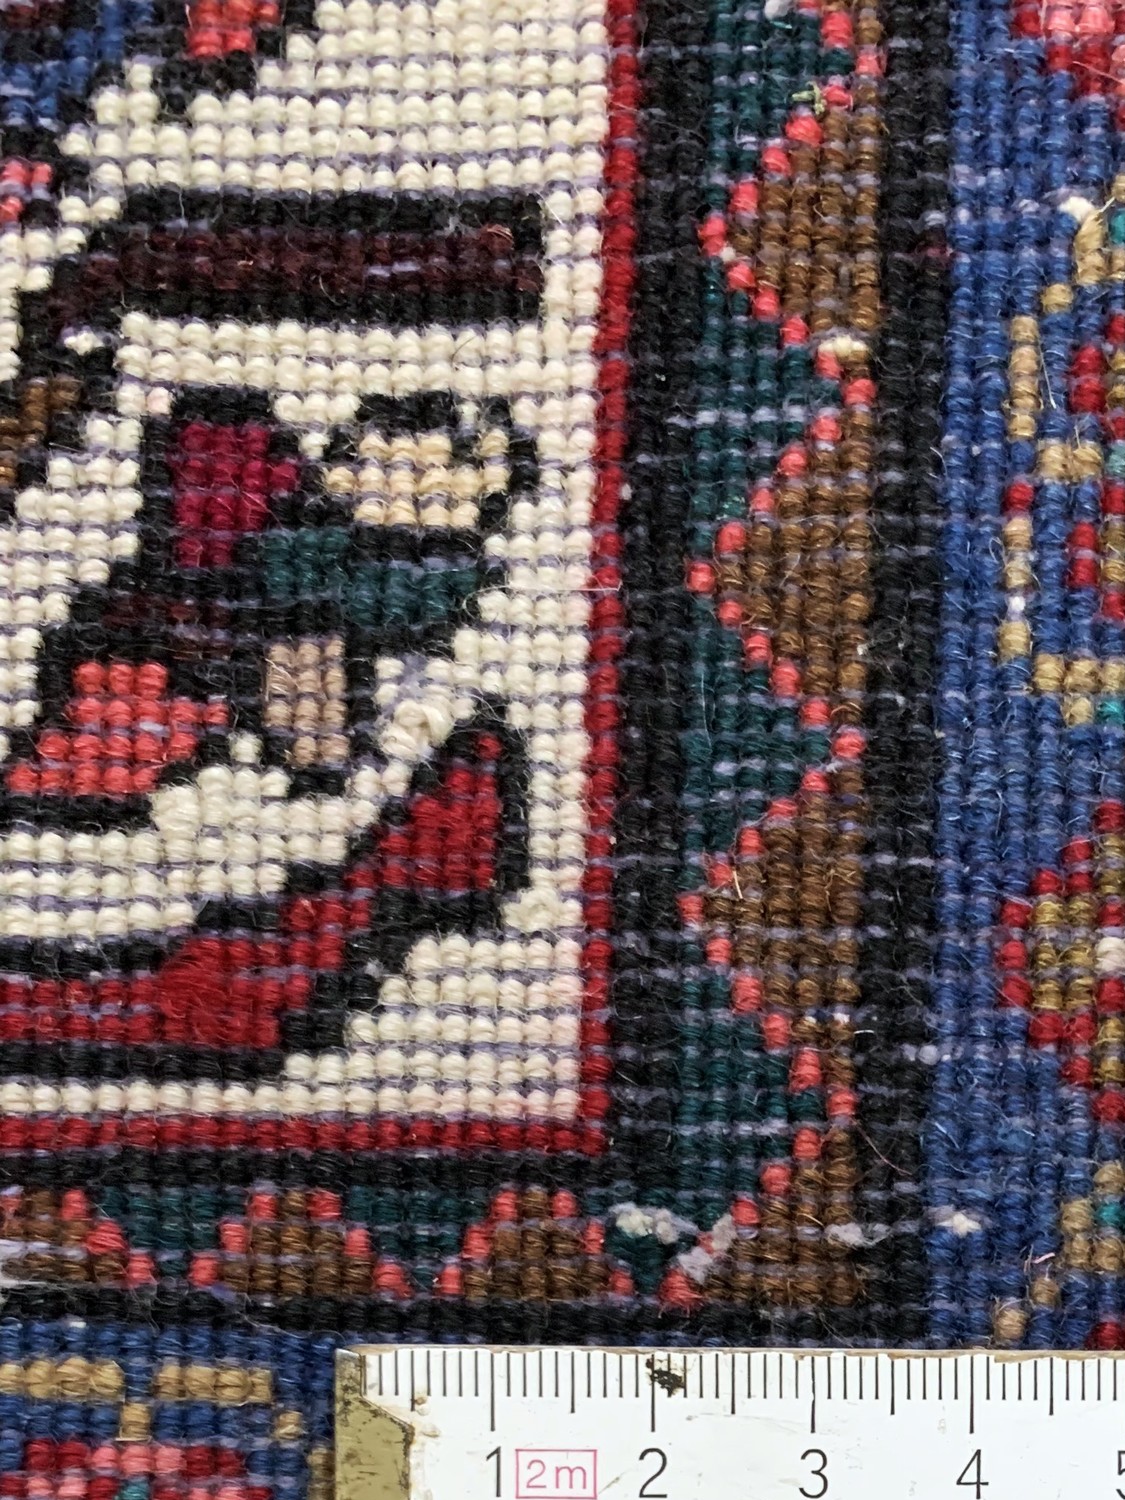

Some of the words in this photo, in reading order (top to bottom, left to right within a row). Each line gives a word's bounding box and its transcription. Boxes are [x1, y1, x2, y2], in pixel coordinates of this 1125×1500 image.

[485, 1446, 501, 1498] 1
[525, 1458, 588, 1490] 2m
[638, 1447, 668, 1499] 2
[798, 1448, 829, 1500] 3
[955, 1448, 989, 1500] 4
